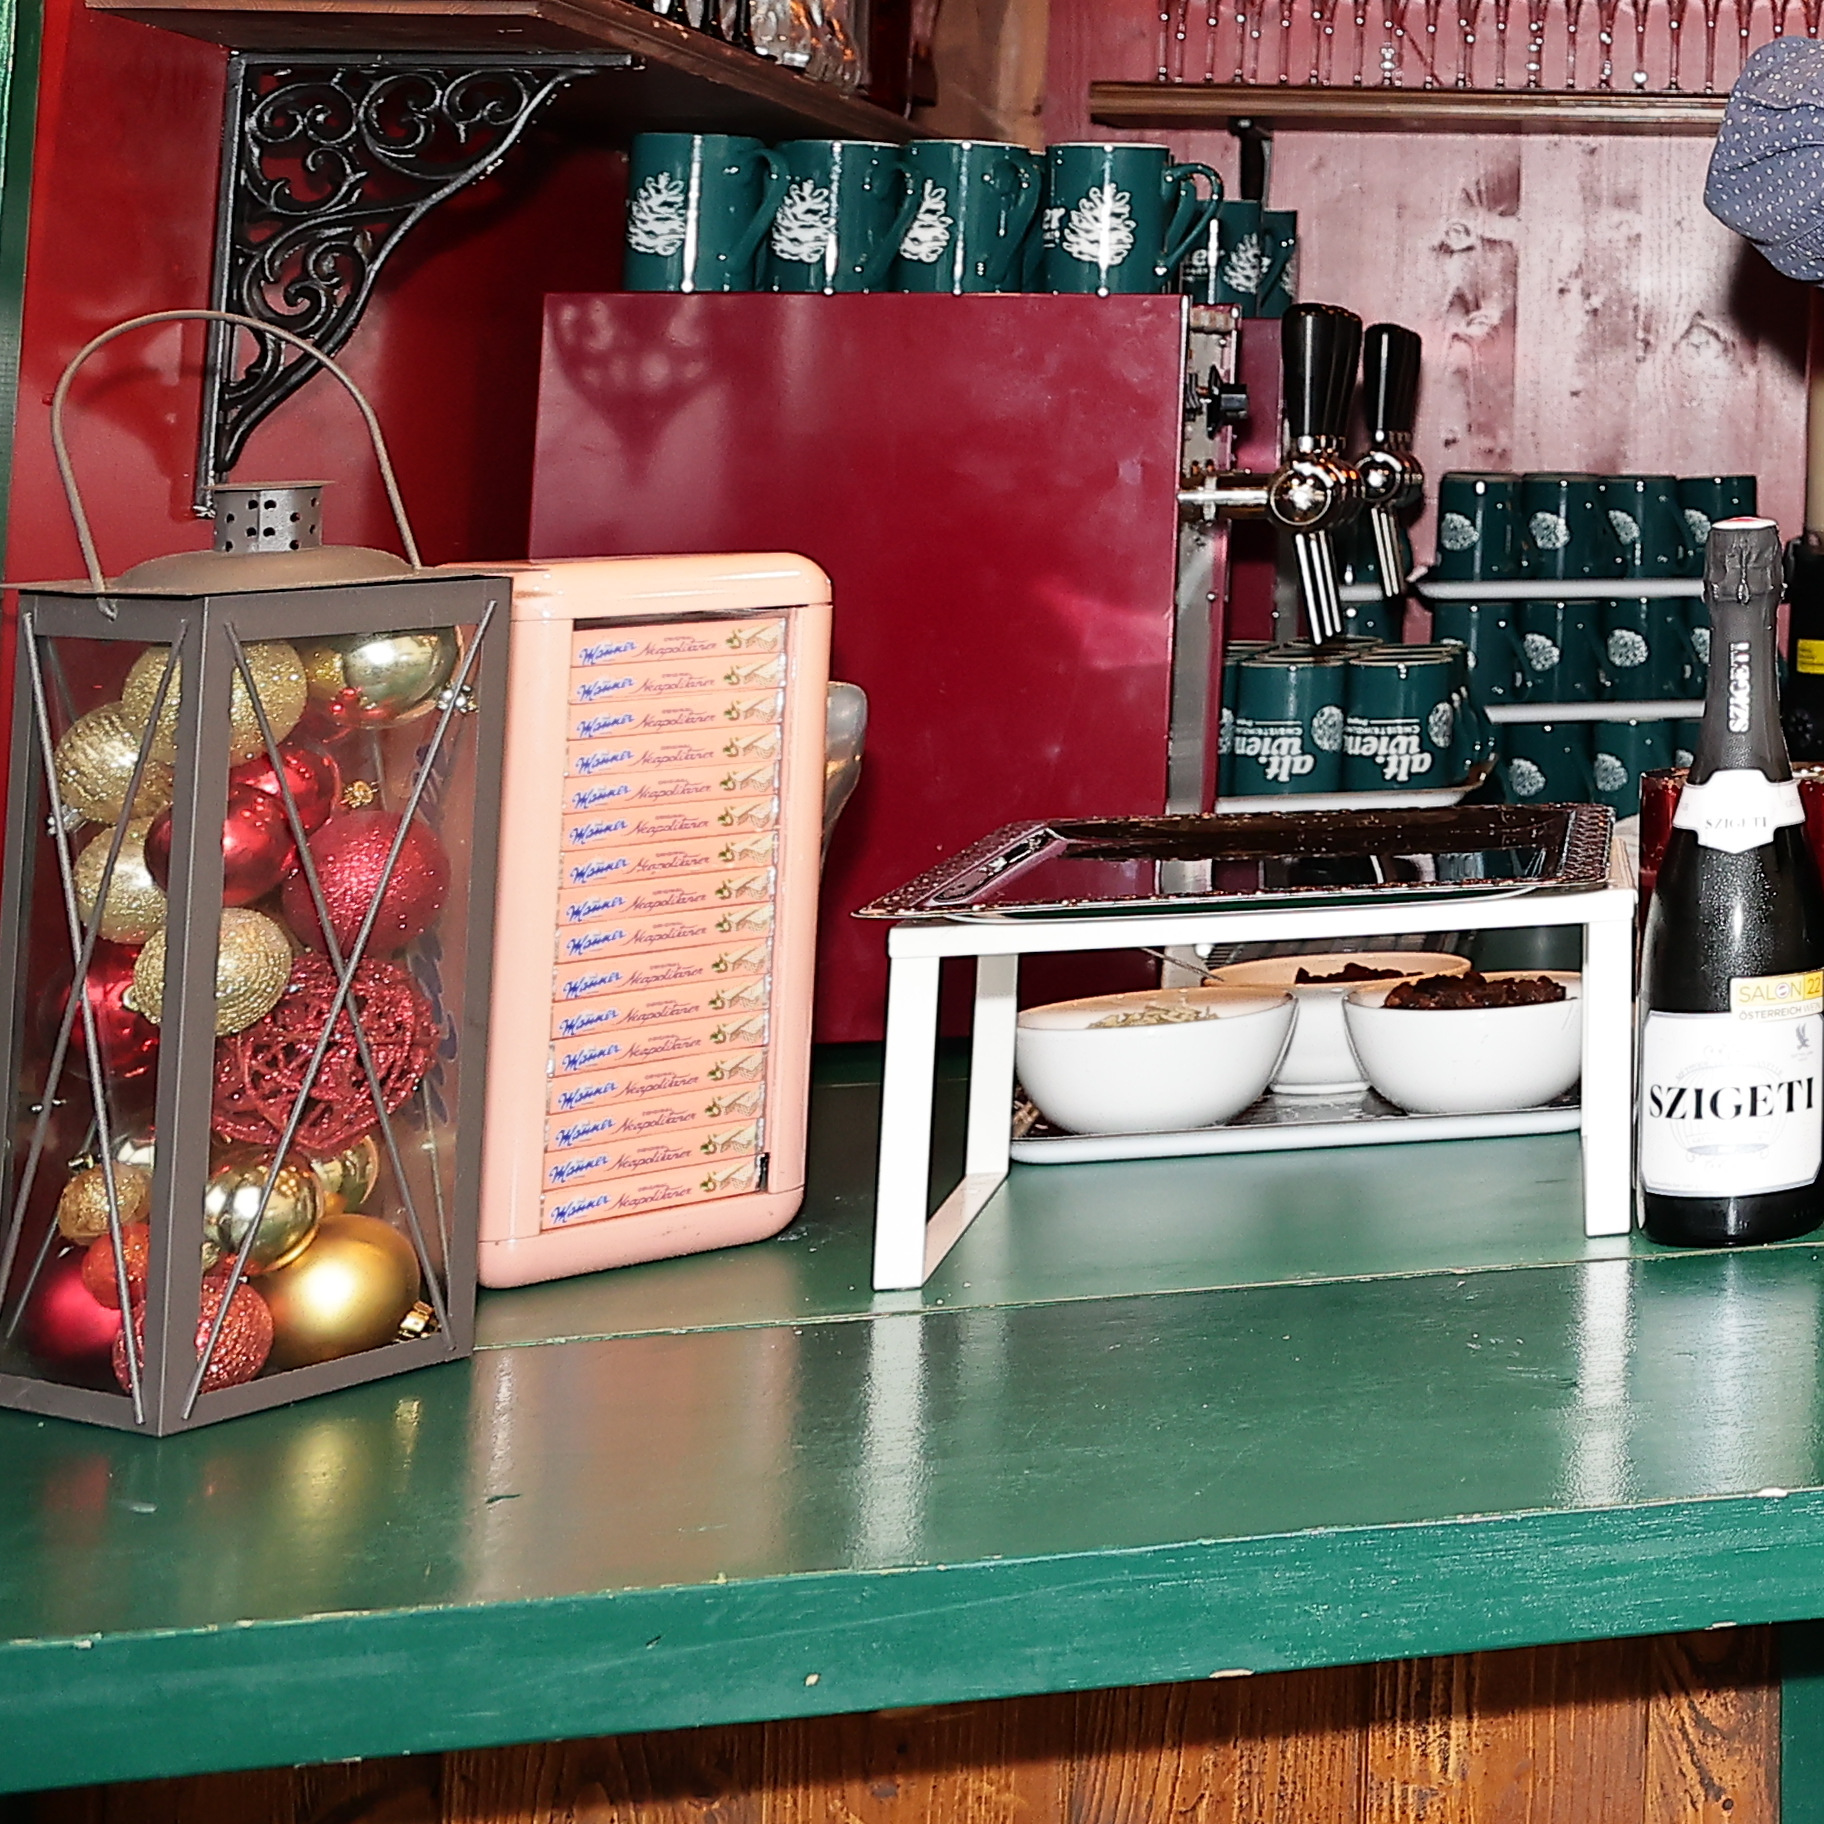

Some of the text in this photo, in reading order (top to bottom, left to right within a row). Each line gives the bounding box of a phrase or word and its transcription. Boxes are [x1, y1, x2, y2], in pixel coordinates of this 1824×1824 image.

[578, 642, 637, 666] Manner
[576, 678, 635, 702] Manner
[1728, 640, 1751, 734] SZIGETI
[576, 714, 636, 738] Manner
[575, 750, 634, 775] Manner
[571, 785, 631, 810] Manner
[569, 820, 628, 845] Manner
[569, 858, 629, 884] Manner
[566, 896, 625, 923] Manner
[566, 930, 626, 956] Manner
[562, 972, 622, 999] Manner
[1806, 975, 1821, 996] 22
[558, 1009, 620, 1037] Manner
[561, 1044, 622, 1071] Manner
[557, 1082, 617, 1110] Manner
[1649, 1077, 1815, 1120] SZIGETI
[555, 1119, 615, 1147] Manner
[548, 1155, 610, 1184] Manner
[550, 1195, 611, 1224] Manner
